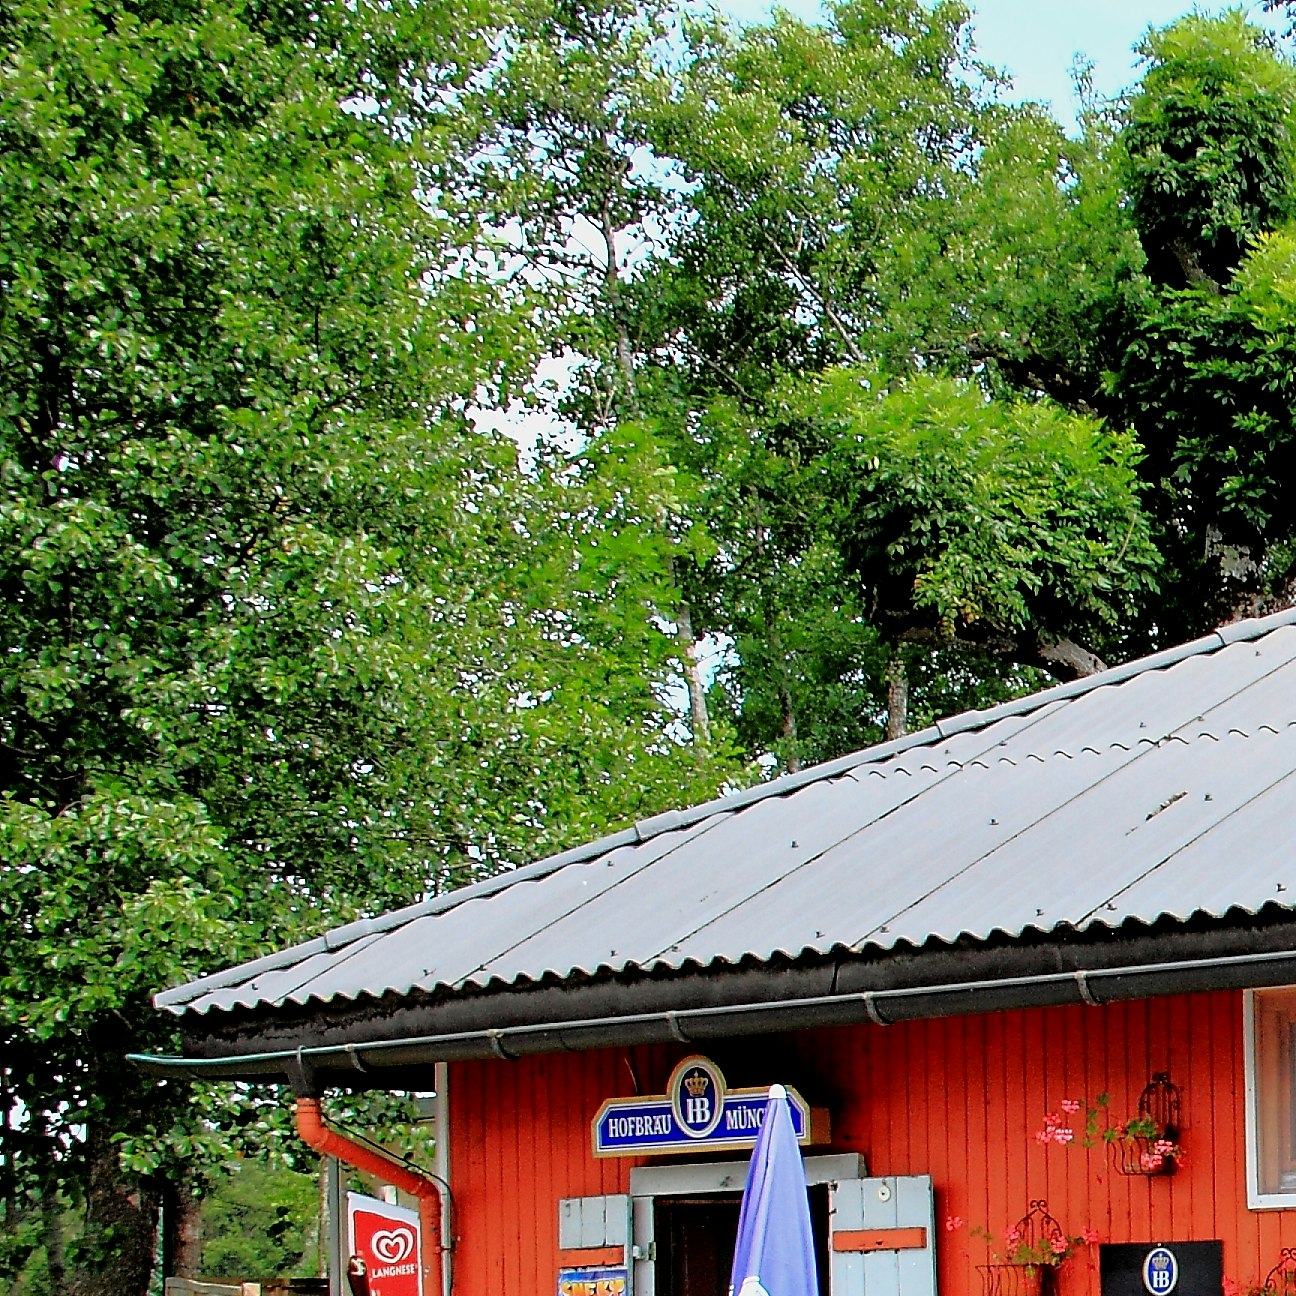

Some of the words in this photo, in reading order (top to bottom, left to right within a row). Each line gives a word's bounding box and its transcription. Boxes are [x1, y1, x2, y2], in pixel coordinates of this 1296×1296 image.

[608, 1114, 671, 1138] HOFBRÄU
[726, 1105, 764, 1131] MÜNC
[686, 1097, 711, 1124] HB
[371, 1263, 415, 1279] LANGNESE
[1152, 1270, 1170, 1288] HB
